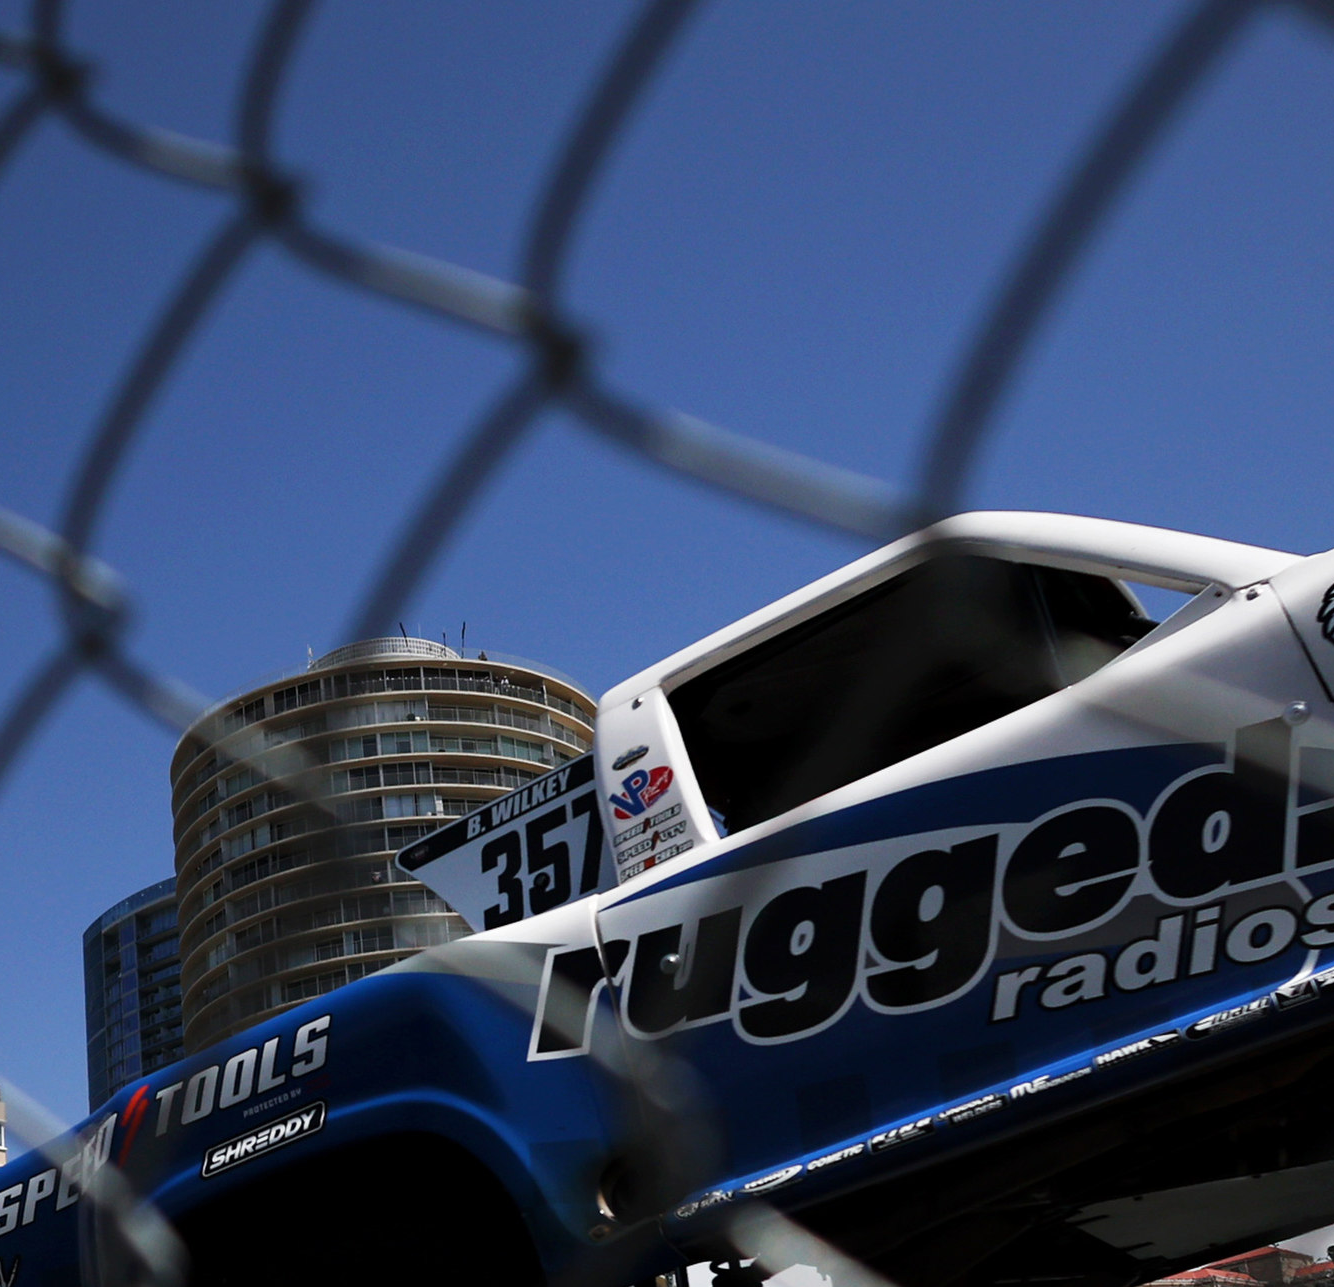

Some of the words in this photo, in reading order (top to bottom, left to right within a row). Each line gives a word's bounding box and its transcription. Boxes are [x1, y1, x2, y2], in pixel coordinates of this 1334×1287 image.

[466, 815, 487, 840] B.
[491, 767, 573, 826] WILKEY
[609, 769, 649, 817] VP
[481, 790, 604, 930] 357
[155, 1014, 332, 1137] TOOLS
[1096, 1038, 1153, 1067] HAWK
[243, 1092, 289, 1119] PROTECTED
[290, 1088, 302, 1099] BY
[210, 1109, 317, 1171] SHREDDY
